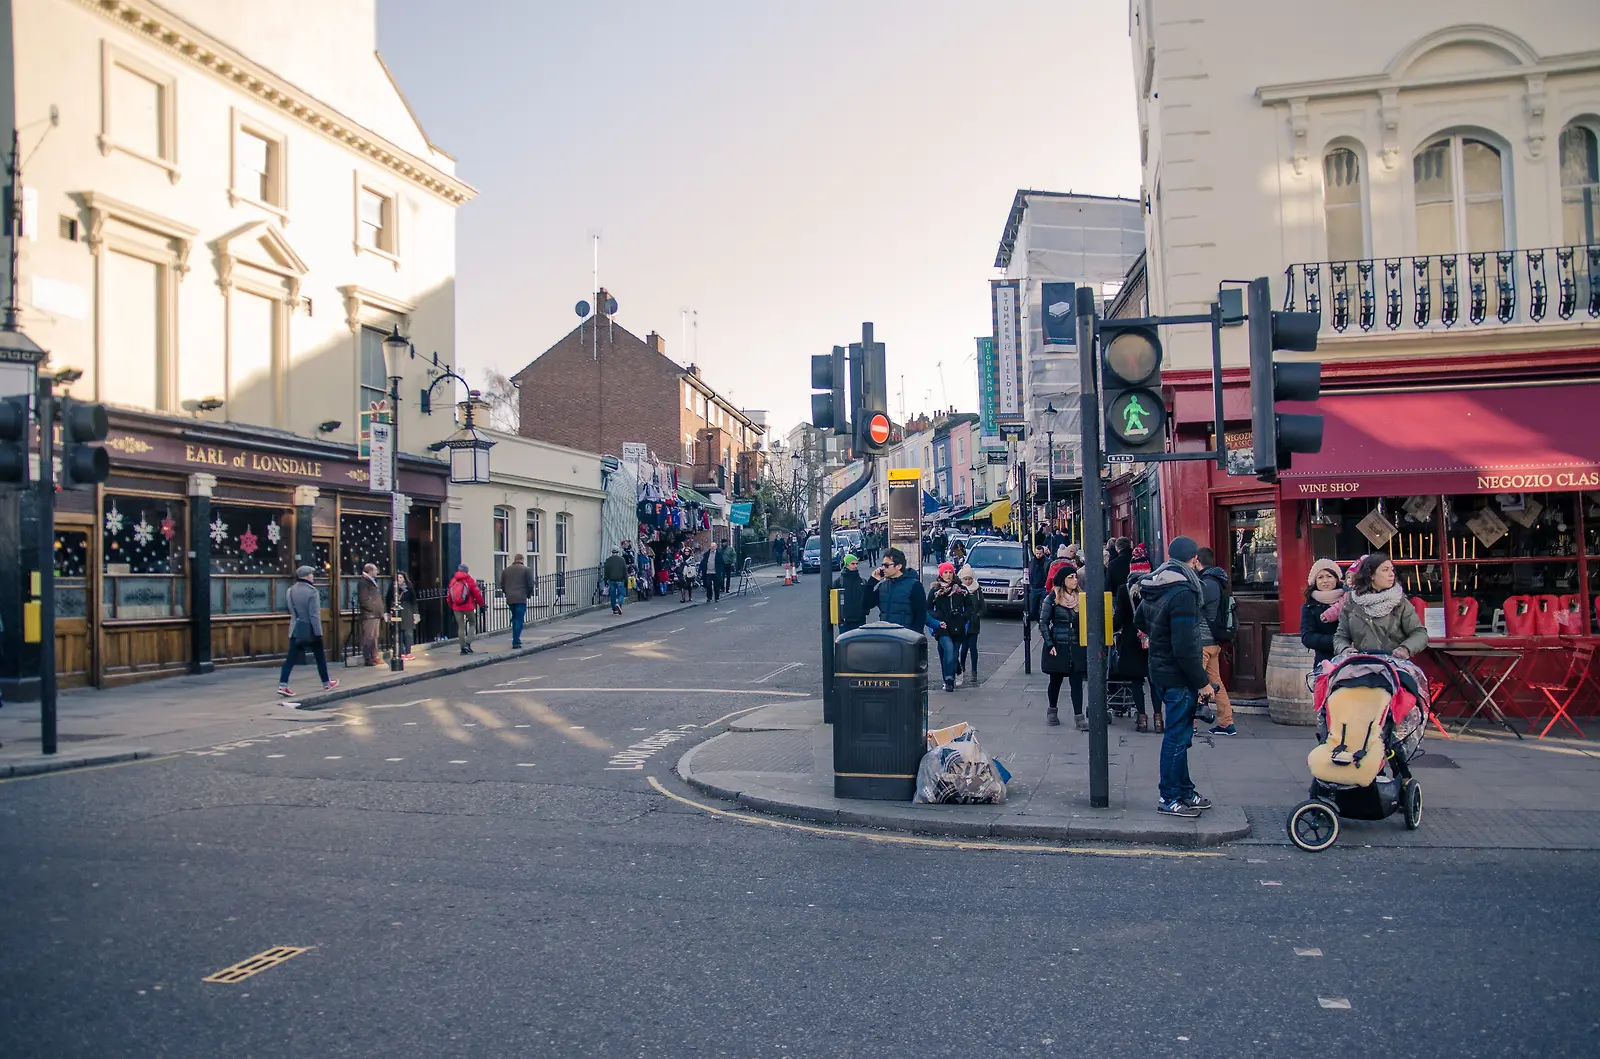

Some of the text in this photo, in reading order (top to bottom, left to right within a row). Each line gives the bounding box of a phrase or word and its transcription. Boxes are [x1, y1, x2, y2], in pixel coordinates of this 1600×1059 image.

[985, 342, 993, 392] HIGHLAND
[185, 445, 322, 477] EARL of LONSDALE
[1298, 482, 1360, 493] WINE SHOP
[1477, 472, 1600, 489] NEGOZIO CLAS
